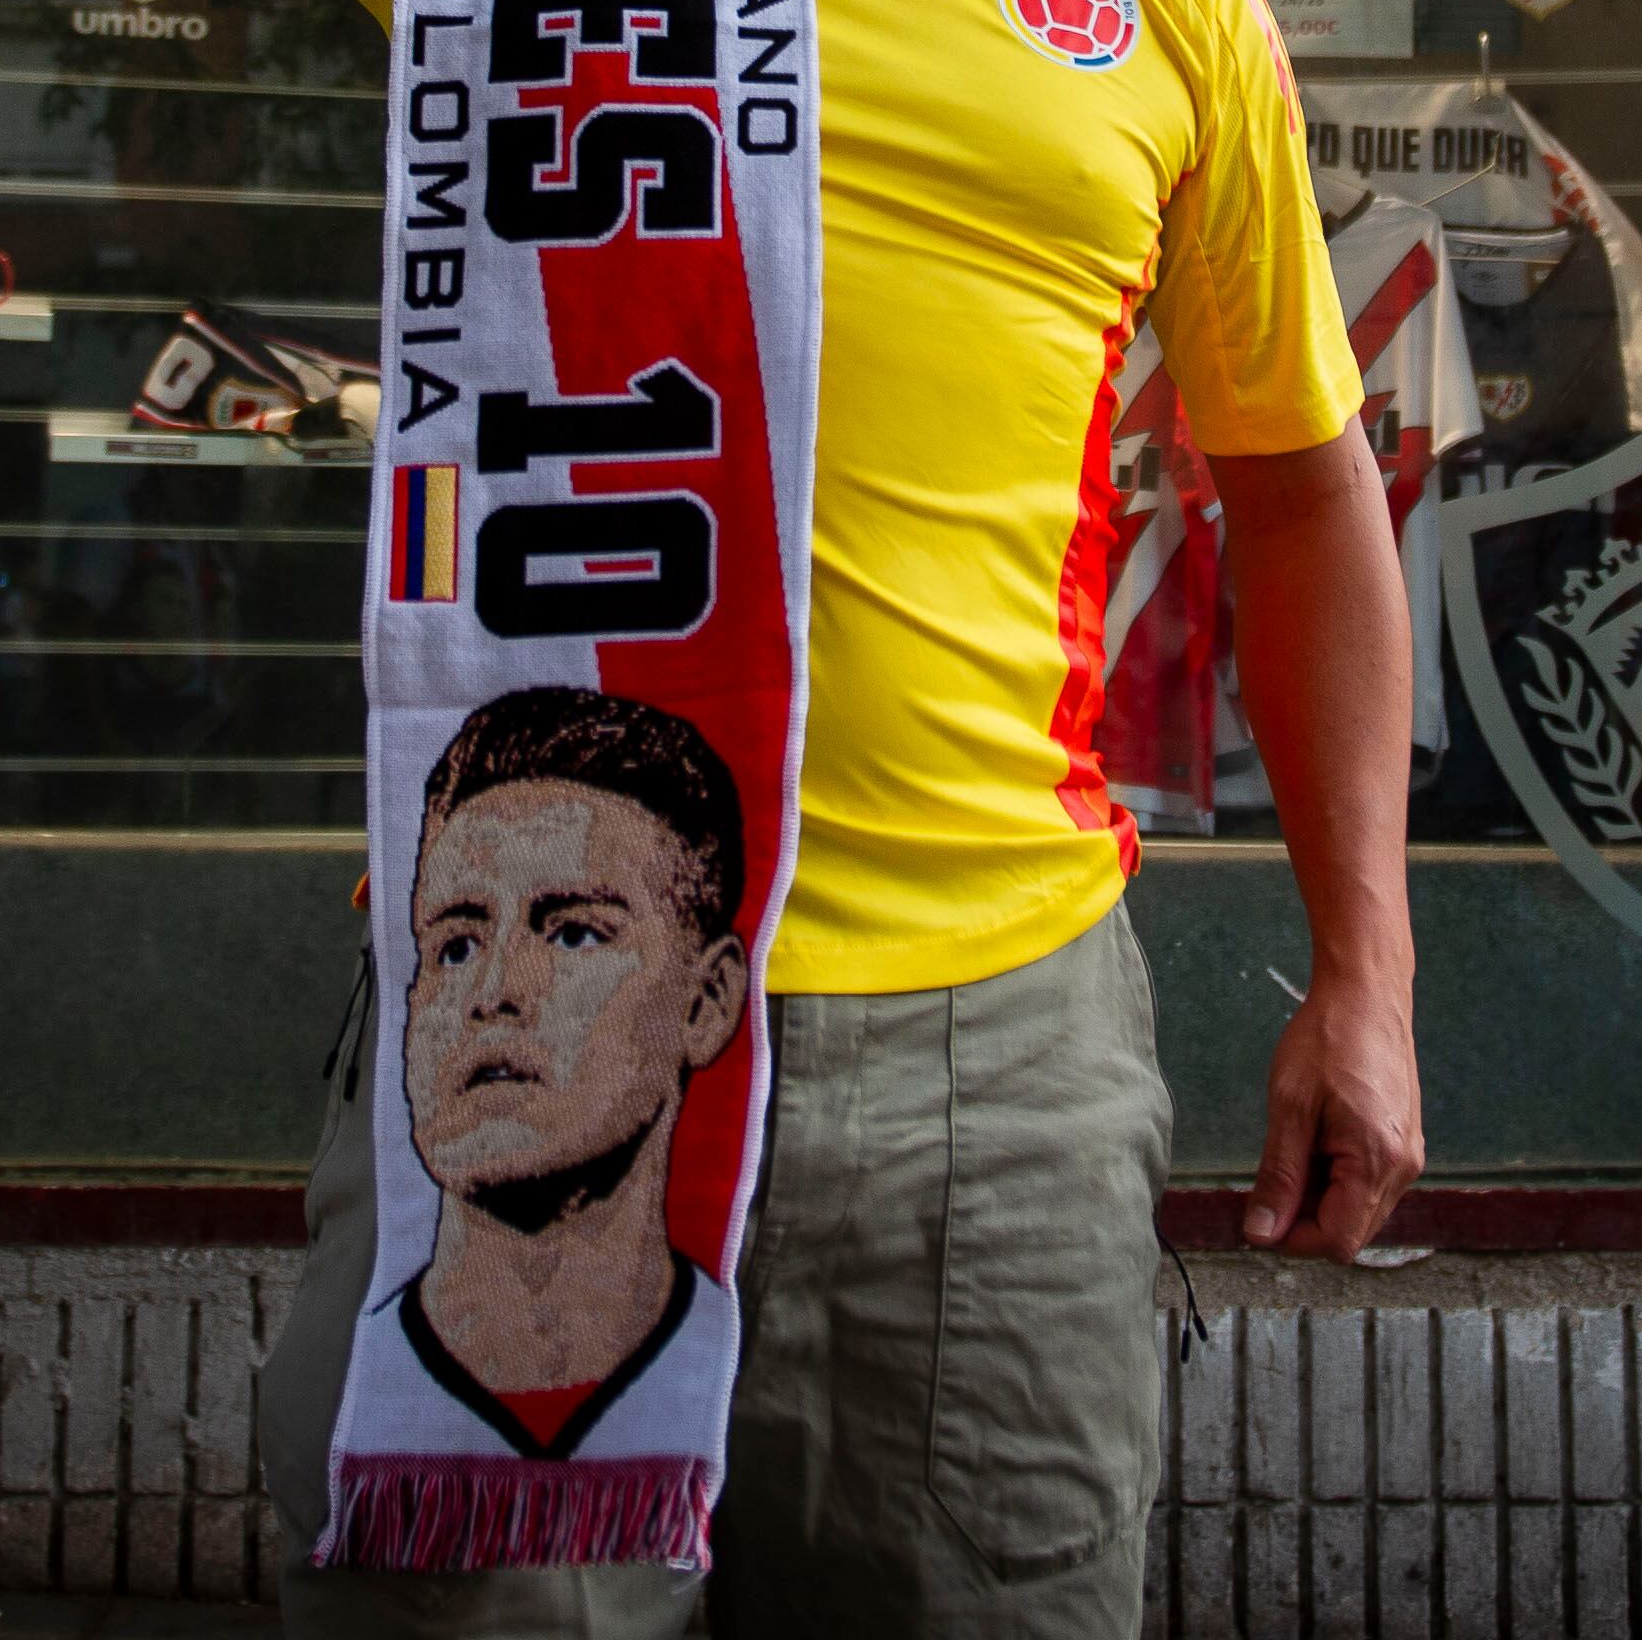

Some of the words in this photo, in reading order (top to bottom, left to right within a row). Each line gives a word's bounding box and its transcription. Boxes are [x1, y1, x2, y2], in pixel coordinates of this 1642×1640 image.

[71, 6, 210, 42] umbro
[1352, 126, 1421, 178] QUE
[477, 365, 715, 638] 10
